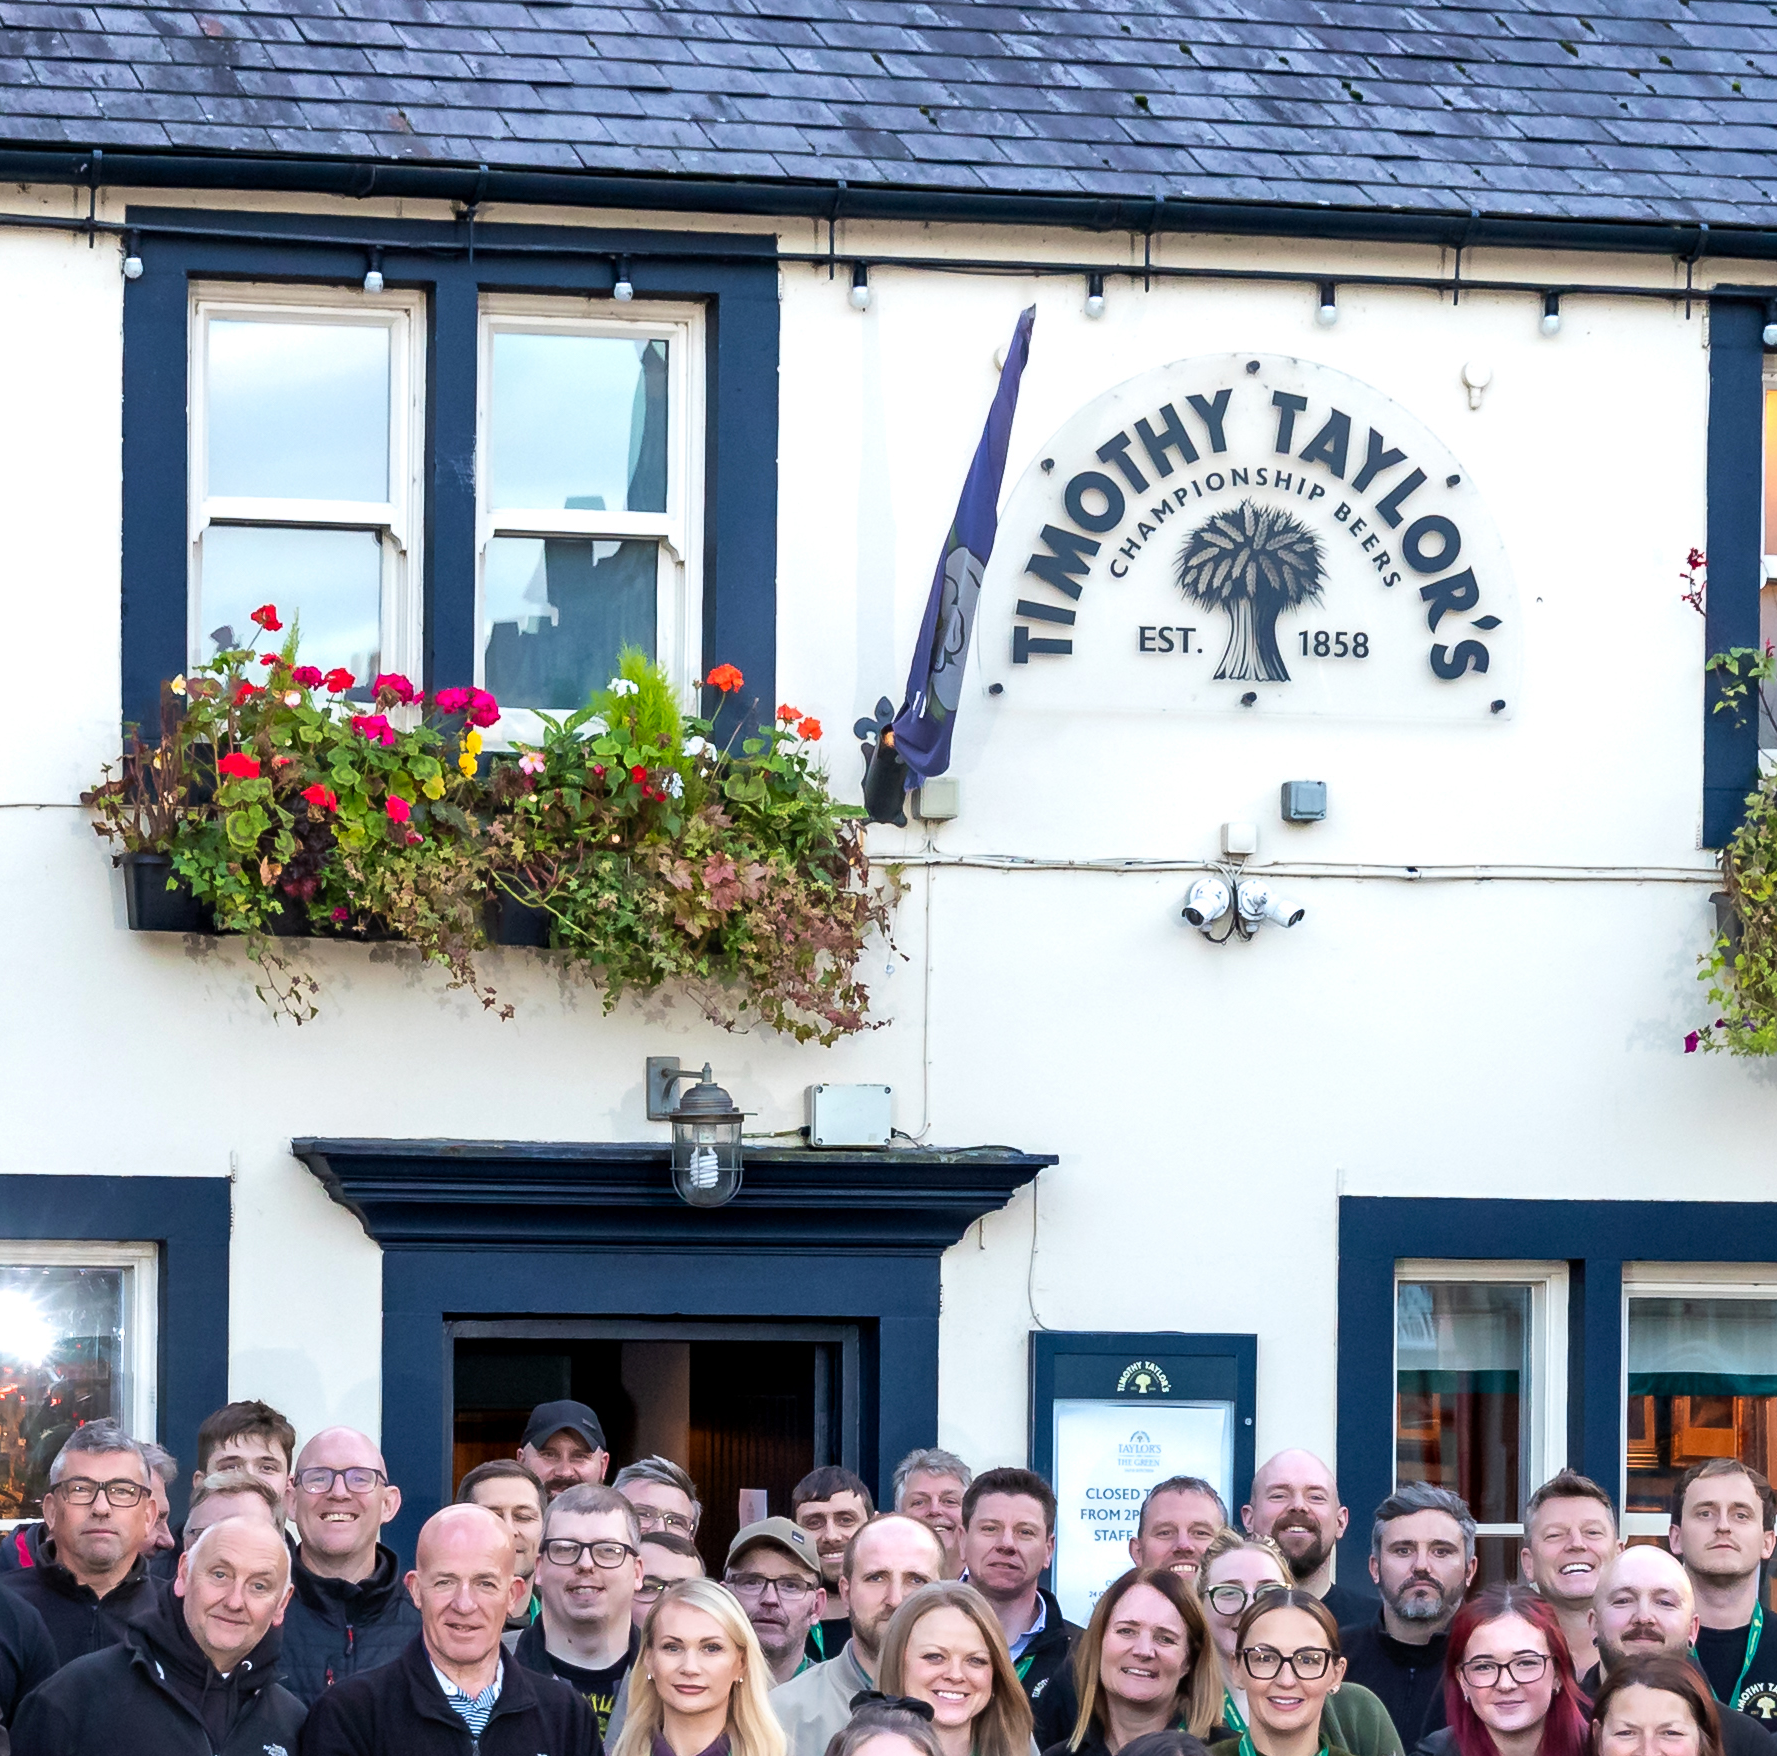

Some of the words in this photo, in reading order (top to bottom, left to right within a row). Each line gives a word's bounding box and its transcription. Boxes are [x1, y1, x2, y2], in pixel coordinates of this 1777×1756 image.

[1109, 466, 1326, 579] CHAMPIONSHIP
[1333, 501, 1403, 588] BEERS
[1012, 387, 1234, 665] TIMOTHY
[1271, 389, 1503, 682] TAYLOR'S
[1139, 625, 1204, 656] EST.
[1297, 630, 1371, 660] 1858
[1116, 1361, 1142, 1392] TIMOTHY
[1144, 1361, 1172, 1393] TAYLOR'S
[1118, 1443, 1162, 1454] TAYLOR'S
[1118, 1458, 1133, 1467] THE
[1085, 1488, 1141, 1501] CLOSED
[1080, 1508, 1121, 1521] FROM
[1094, 1529, 1133, 1541] STAFF
